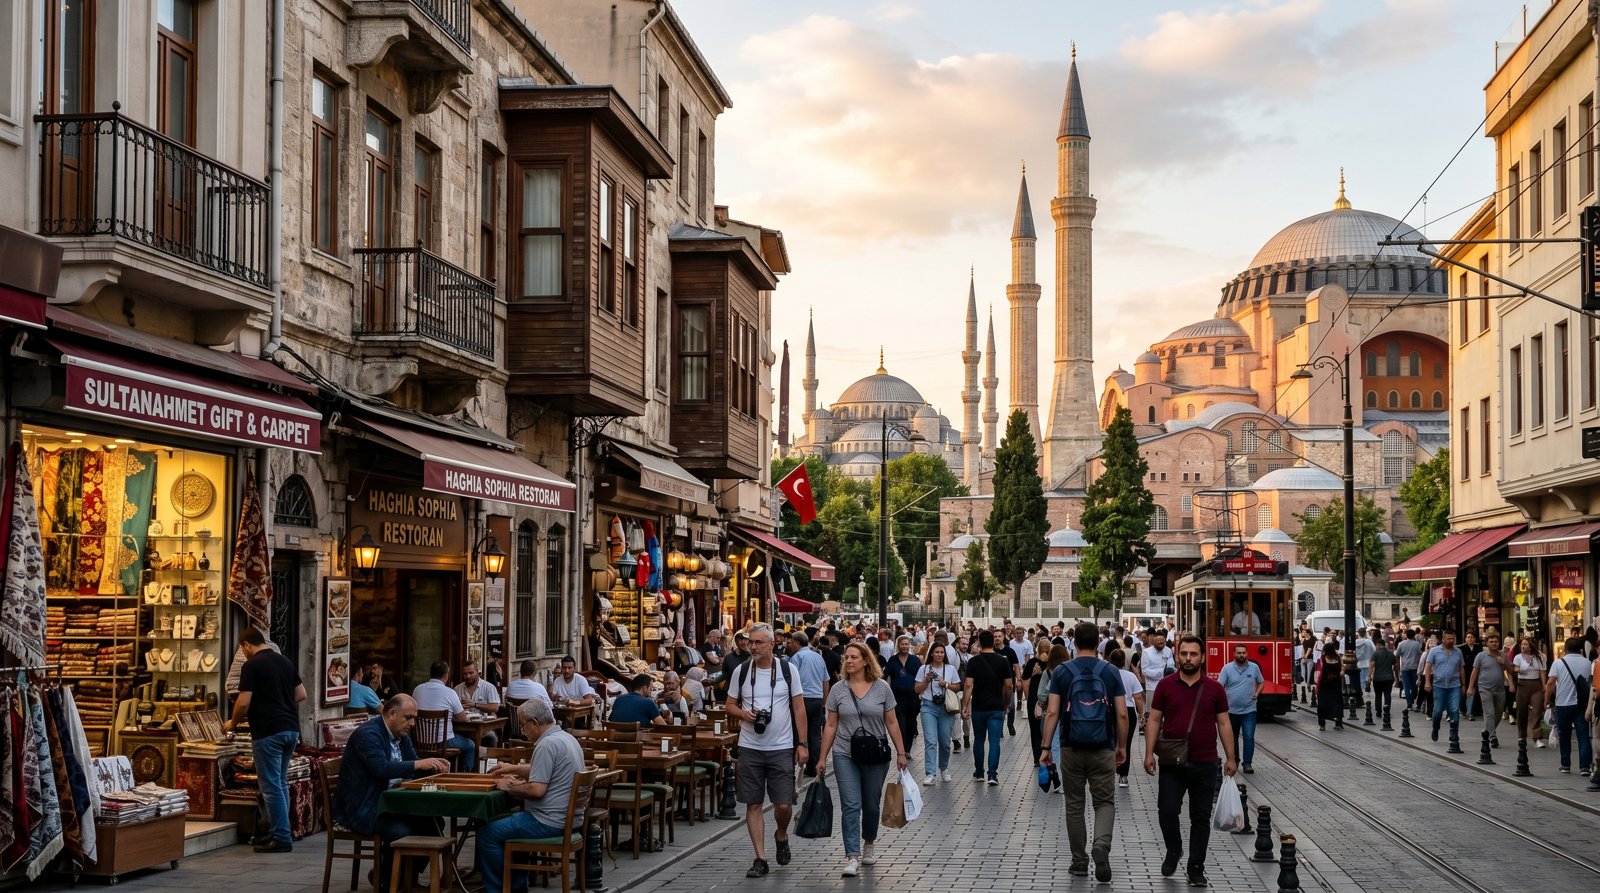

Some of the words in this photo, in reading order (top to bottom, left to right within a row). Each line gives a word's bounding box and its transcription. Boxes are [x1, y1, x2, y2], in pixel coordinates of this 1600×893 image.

[84, 377, 207, 425] SULTANAHMET
[210, 404, 244, 433] GIFT
[246, 412, 257, 436] &
[260, 415, 310, 445] CARPET
[445, 469, 482, 494] HAGHIA
[485, 477, 517, 500] SOPHIA
[518, 484, 560, 506] RESTORAN
[369, 489, 415, 516] HAGHIA
[418, 496, 457, 521] SOPHIA
[384, 521, 444, 547] RESTORAN
